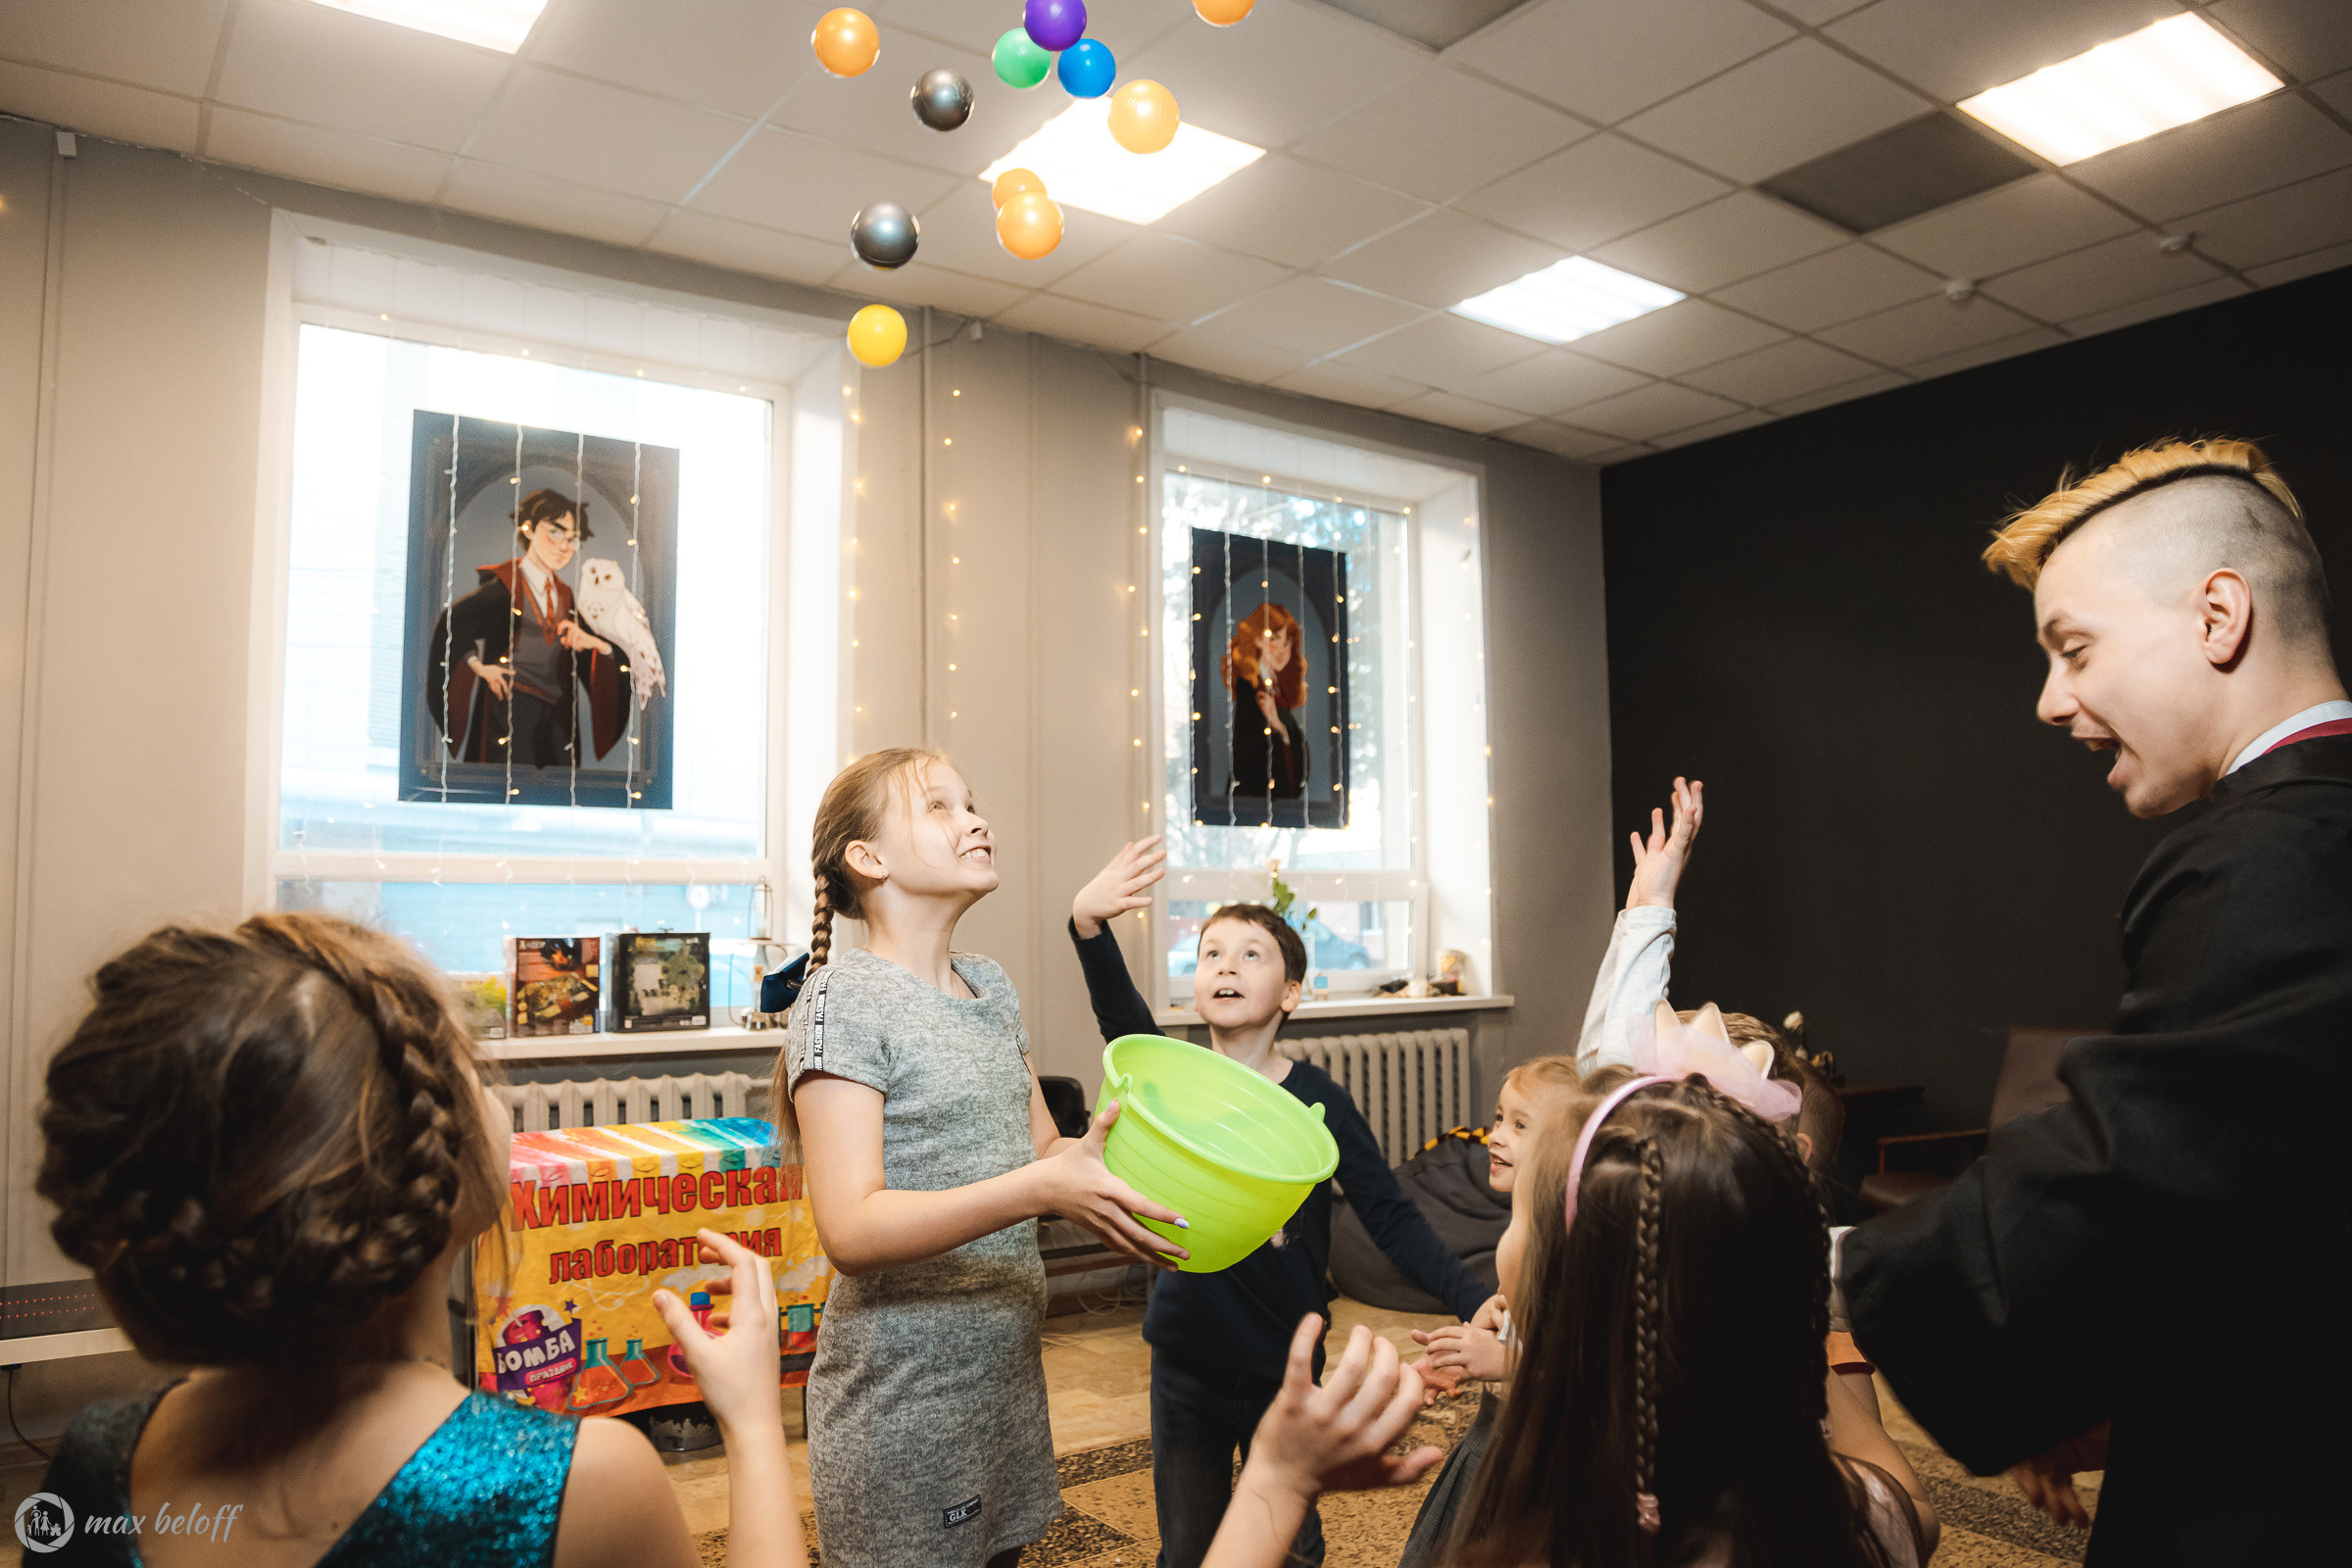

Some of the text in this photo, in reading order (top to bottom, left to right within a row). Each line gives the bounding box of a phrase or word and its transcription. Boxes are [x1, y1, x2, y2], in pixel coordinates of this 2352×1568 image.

[815, 994, 826, 1021] FASHION
[813, 1024, 824, 1054] FASHION
[549, 1227, 783, 1285] лаборатия
[950, 1508, 967, 1521] GLK
